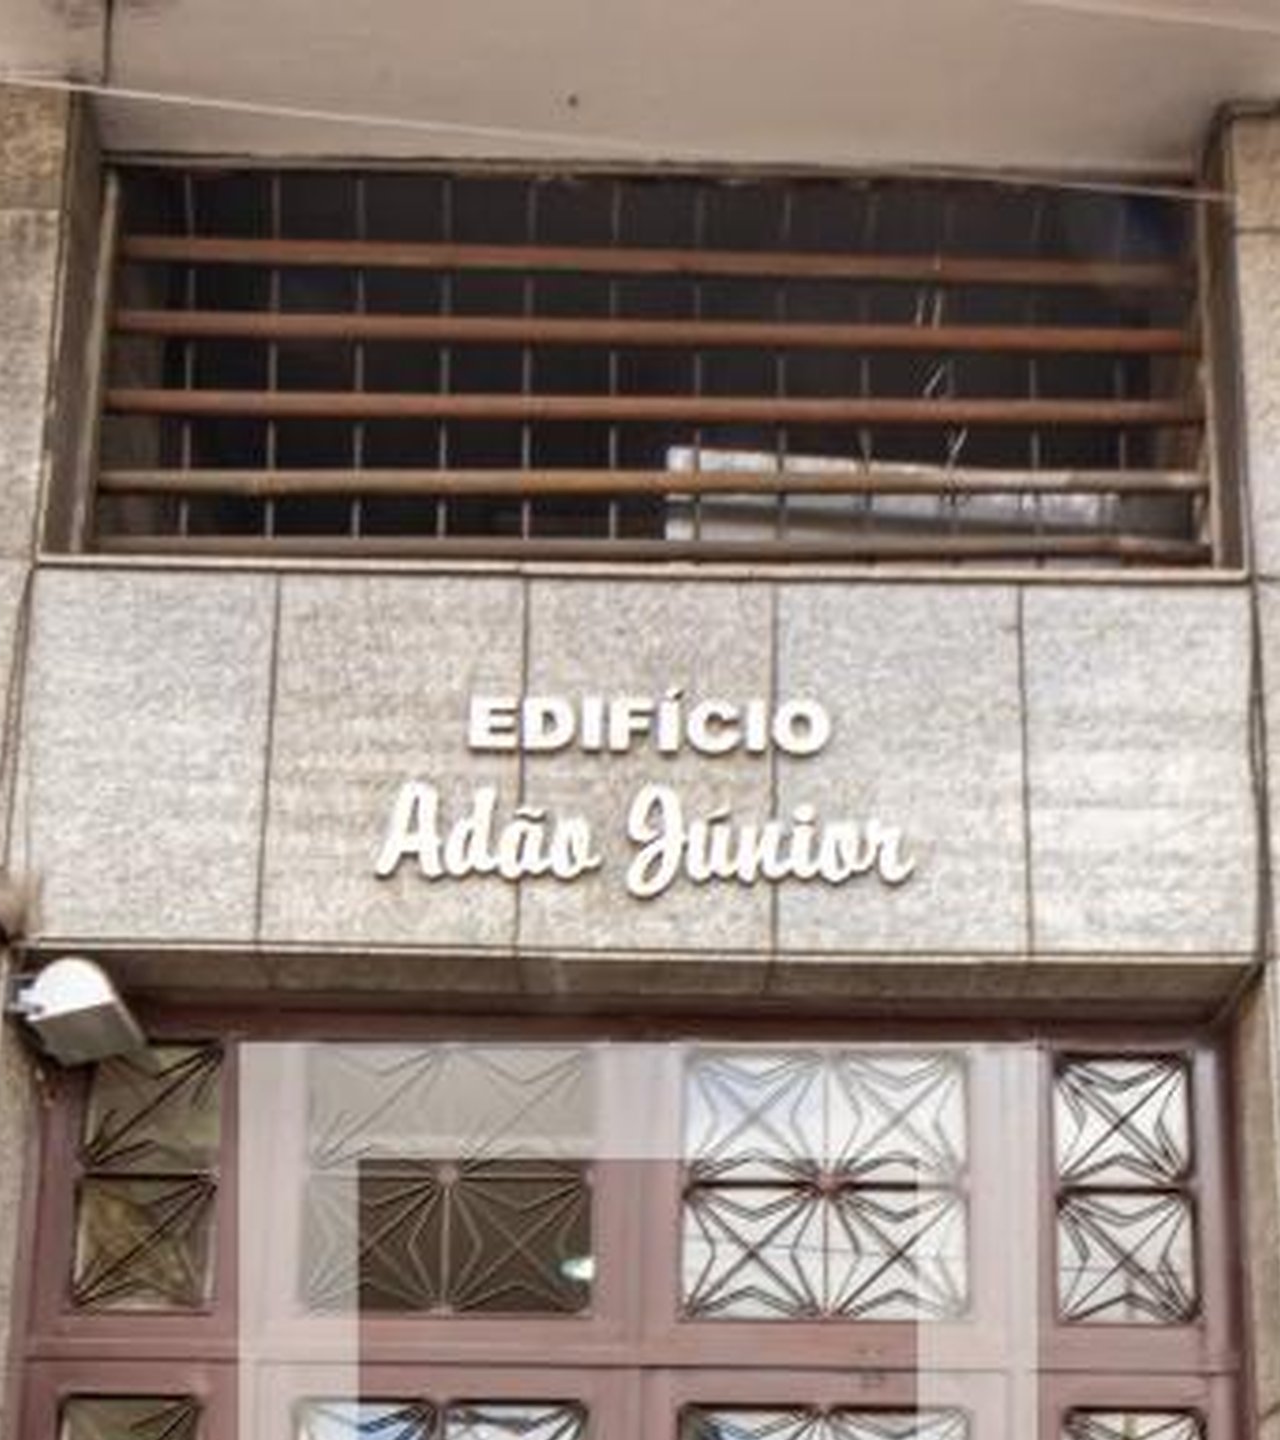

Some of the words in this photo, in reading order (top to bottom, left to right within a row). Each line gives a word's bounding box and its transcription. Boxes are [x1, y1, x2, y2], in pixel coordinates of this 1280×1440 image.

[467, 690, 832, 756] EDIFÍCIO
[375, 780, 602, 882] Adão
[626, 782, 915, 899] Júnior
